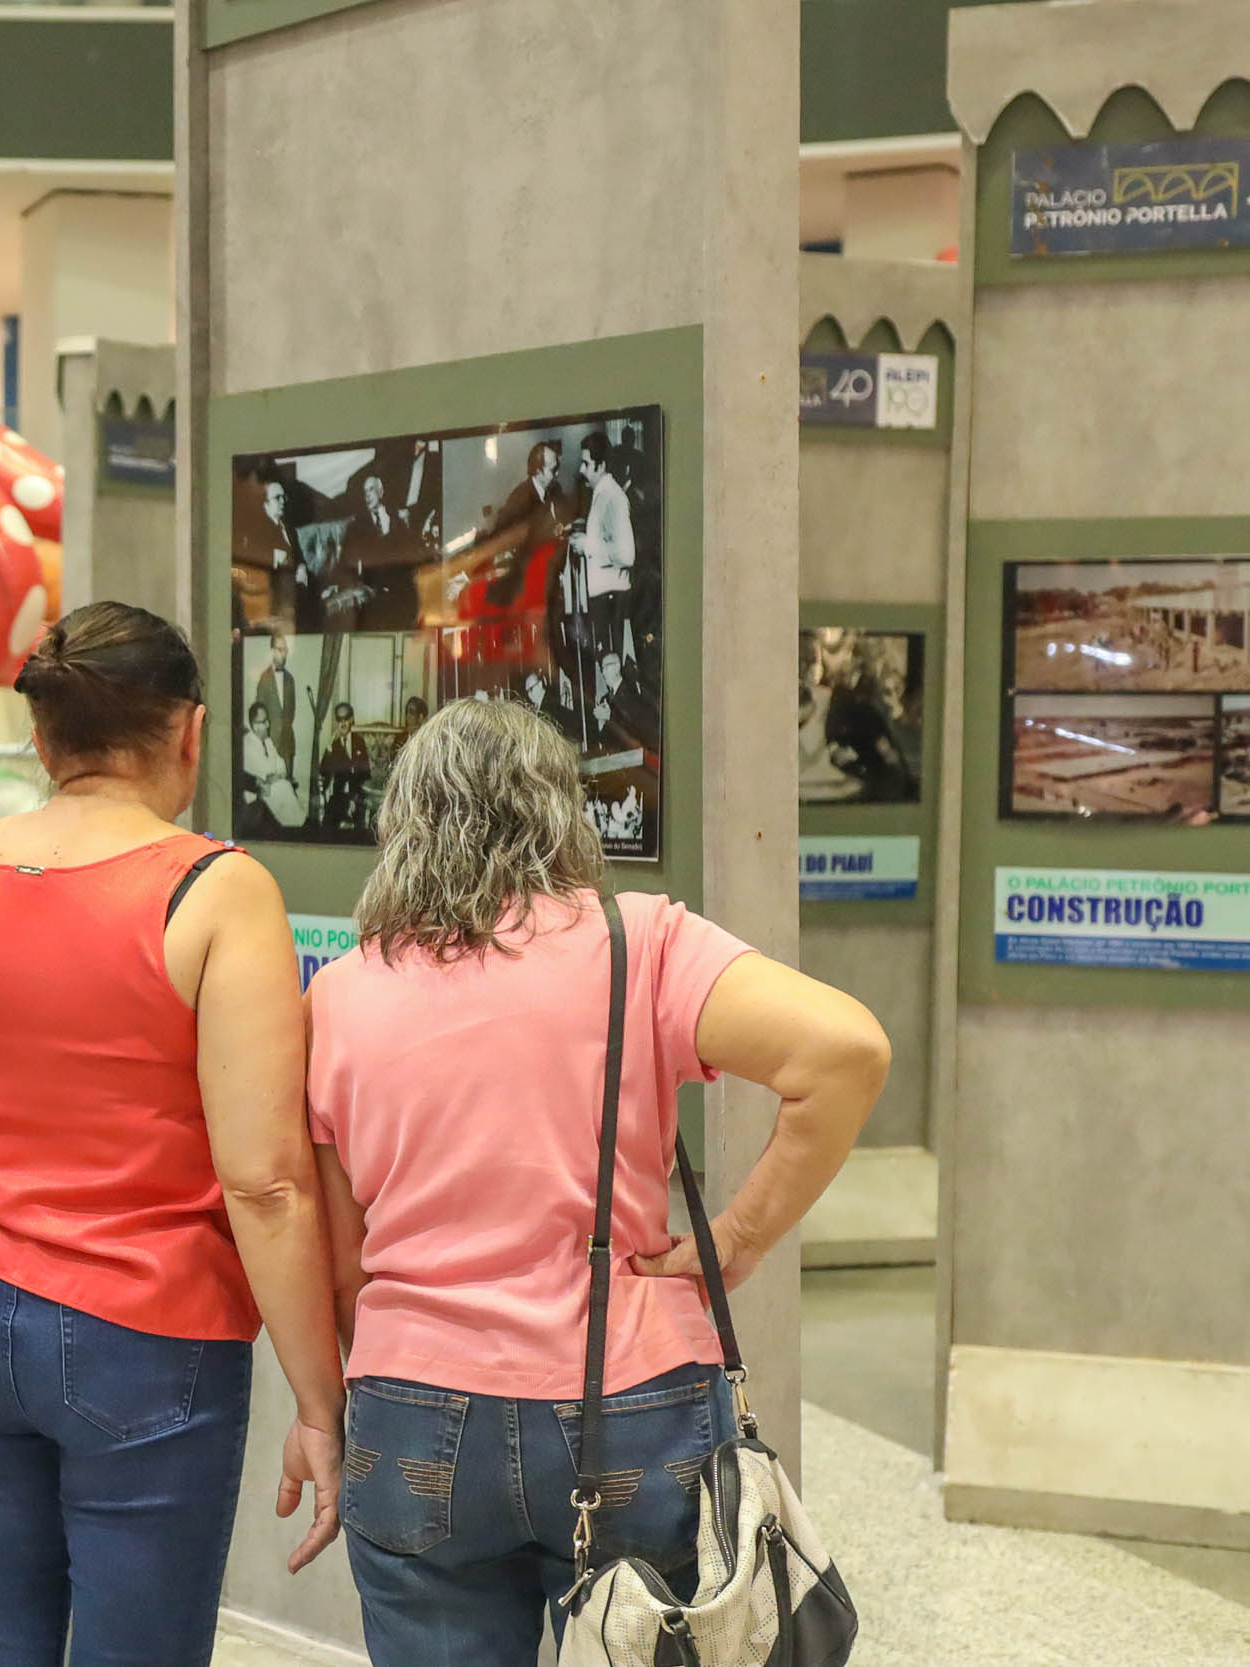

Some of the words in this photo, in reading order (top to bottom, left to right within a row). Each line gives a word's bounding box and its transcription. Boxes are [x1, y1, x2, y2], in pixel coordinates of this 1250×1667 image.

[1125, 202, 1228, 225] PORTELLA
[830, 368, 873, 407] 40
[806, 853, 826, 873] DO
[1008, 876, 1021, 889] O
[1025, 875, 1100, 891] PALÁCIO
[1106, 877, 1198, 895] PETRÔNIO
[1007, 893, 1204, 932] CONSTRUÇÃO
